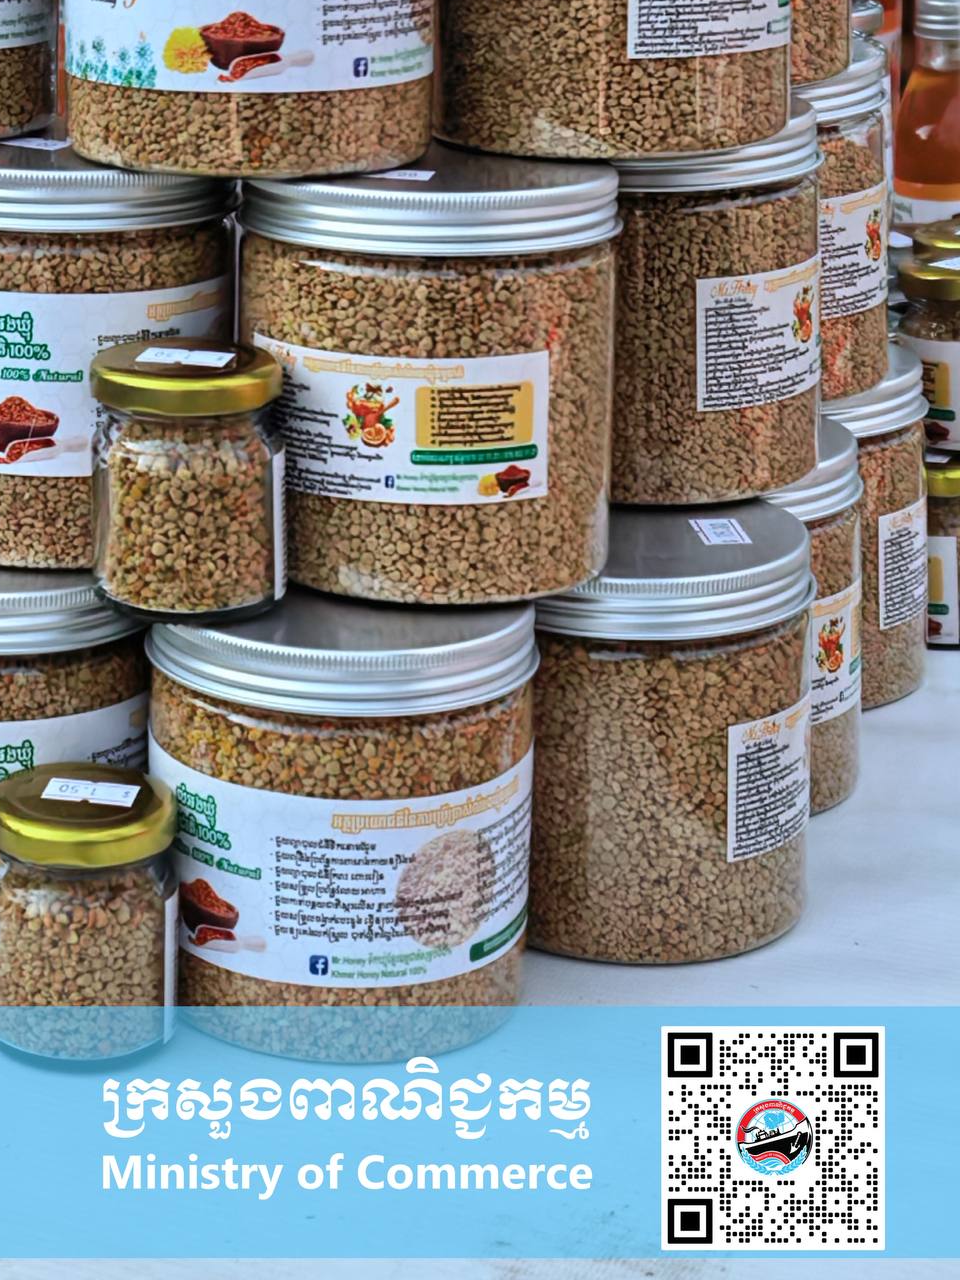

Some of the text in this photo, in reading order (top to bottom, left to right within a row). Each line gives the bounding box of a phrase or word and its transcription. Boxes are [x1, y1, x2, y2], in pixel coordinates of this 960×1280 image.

[8, 342, 50, 361] 100%
[1, 367, 29, 381] 100%
[33, 369, 83, 383] Natural
[216, 853, 261, 880] Natural
